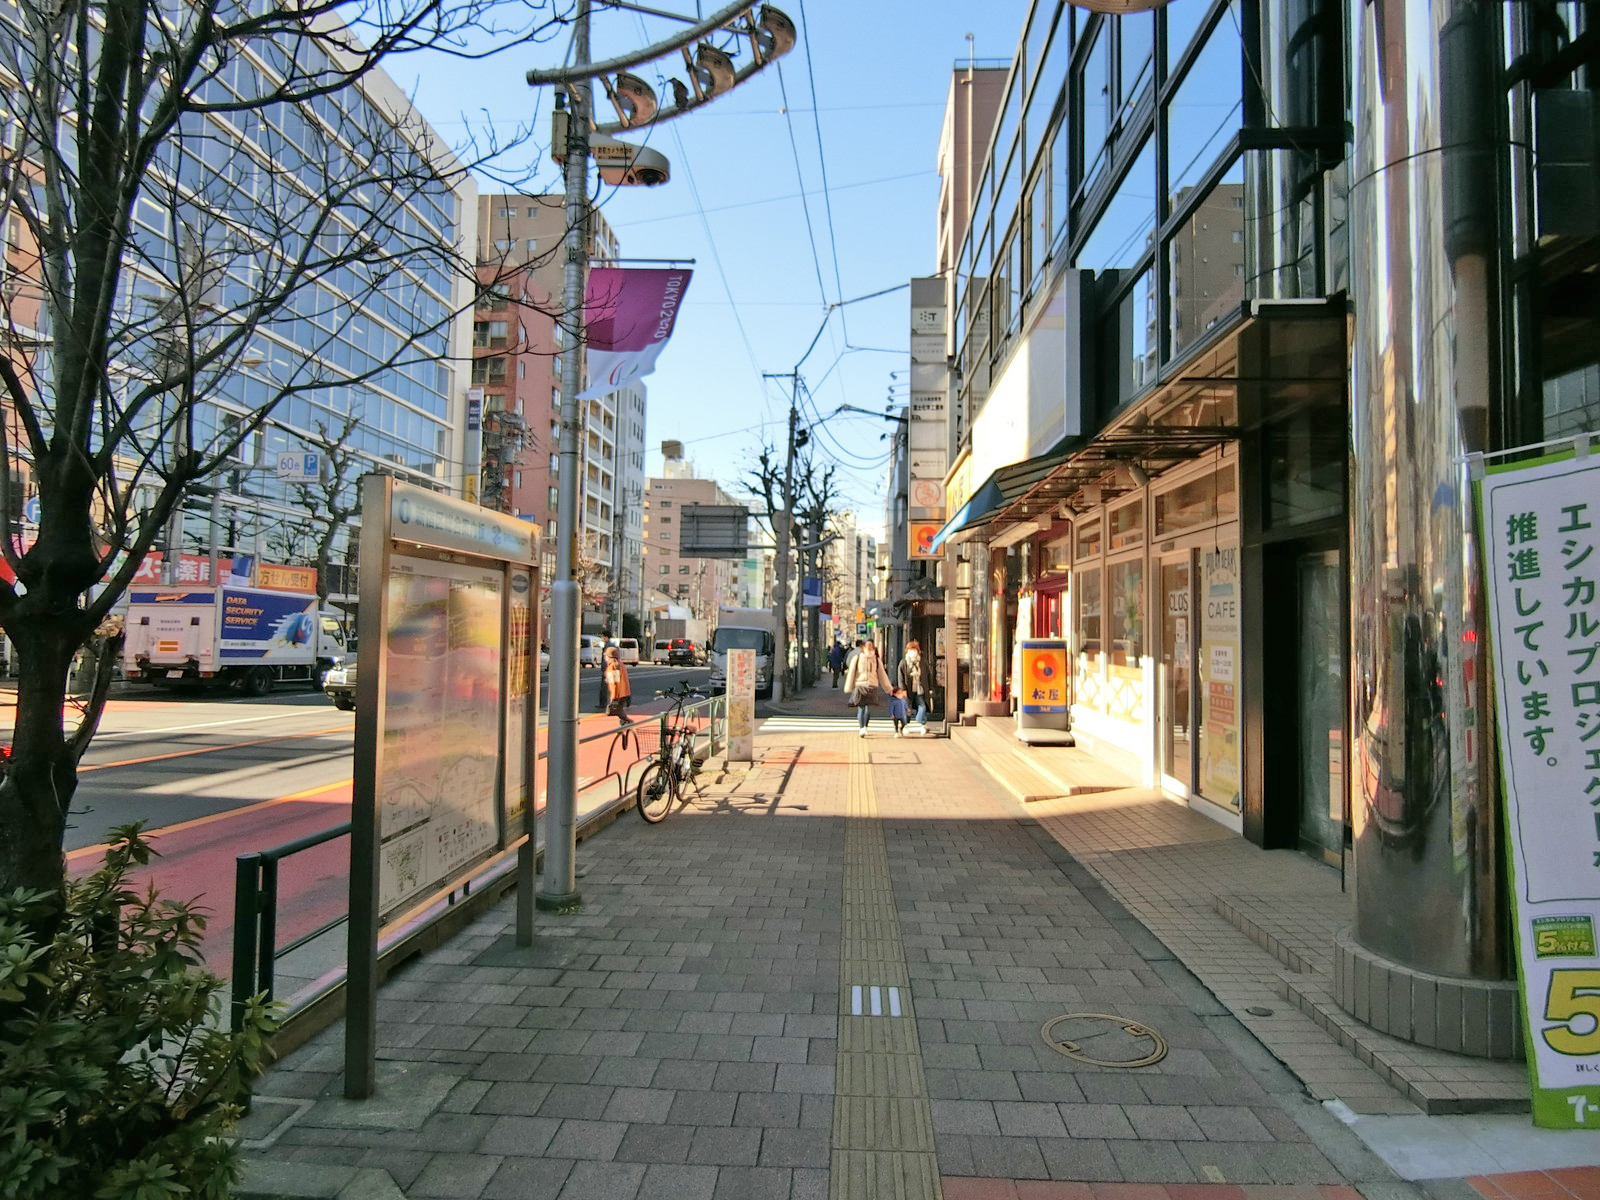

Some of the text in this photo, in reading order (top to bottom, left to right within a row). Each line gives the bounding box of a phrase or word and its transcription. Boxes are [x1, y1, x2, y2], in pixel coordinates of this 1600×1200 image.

[307, 455, 316, 468] P
[226, 596, 248, 605] DATA
[225, 606, 265, 616] SECURITY
[1207, 601, 1236, 619] CAFE
[224, 616, 259, 626] SERVICE
[1506, 511, 1557, 767] 推進しています。
[1032, 688, 1059, 701] 松屋
